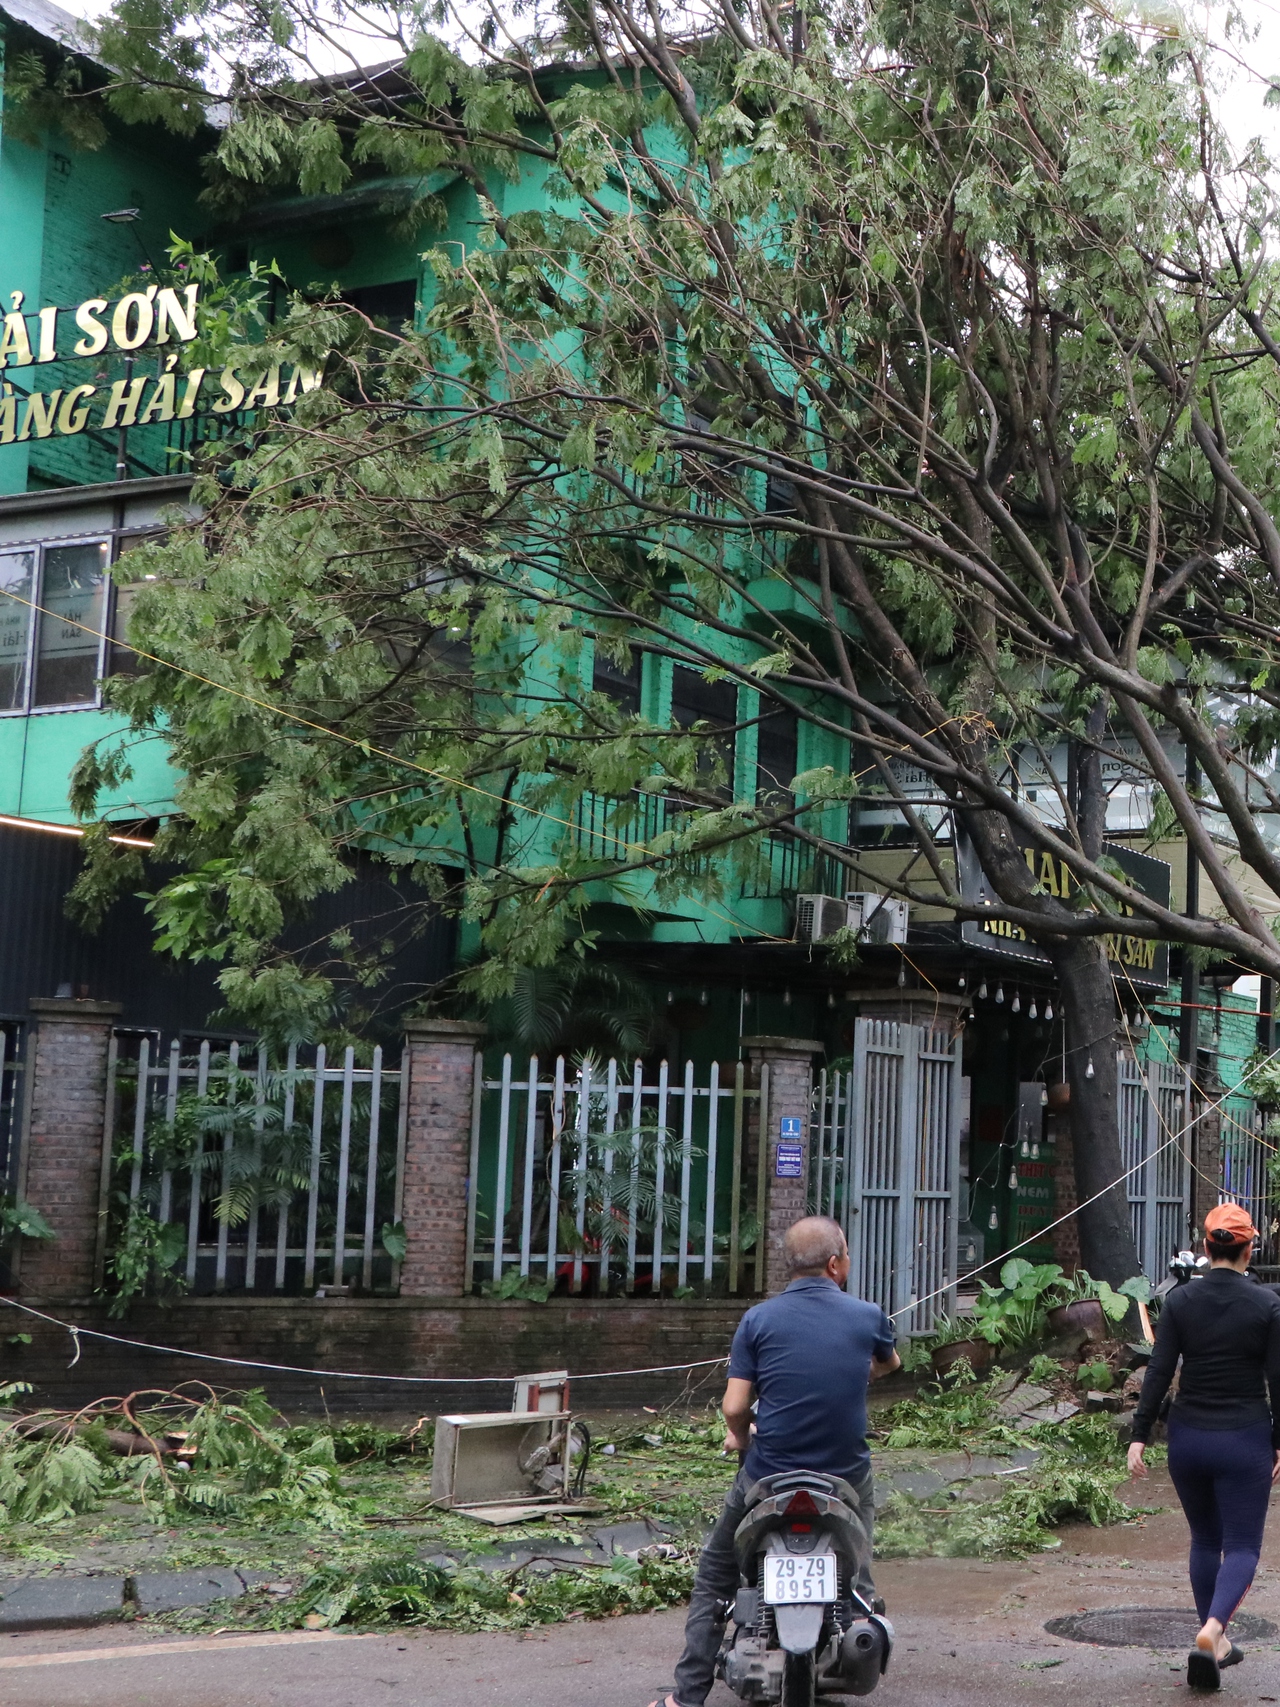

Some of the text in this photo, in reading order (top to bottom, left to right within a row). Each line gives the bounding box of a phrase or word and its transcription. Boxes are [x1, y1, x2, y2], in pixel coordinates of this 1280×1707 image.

[73, 284, 199, 357] SƠN
[101, 354, 205, 429] HẢI
[787, 1119, 794, 1132] 1
[776, 1579, 825, 1600] 8951
